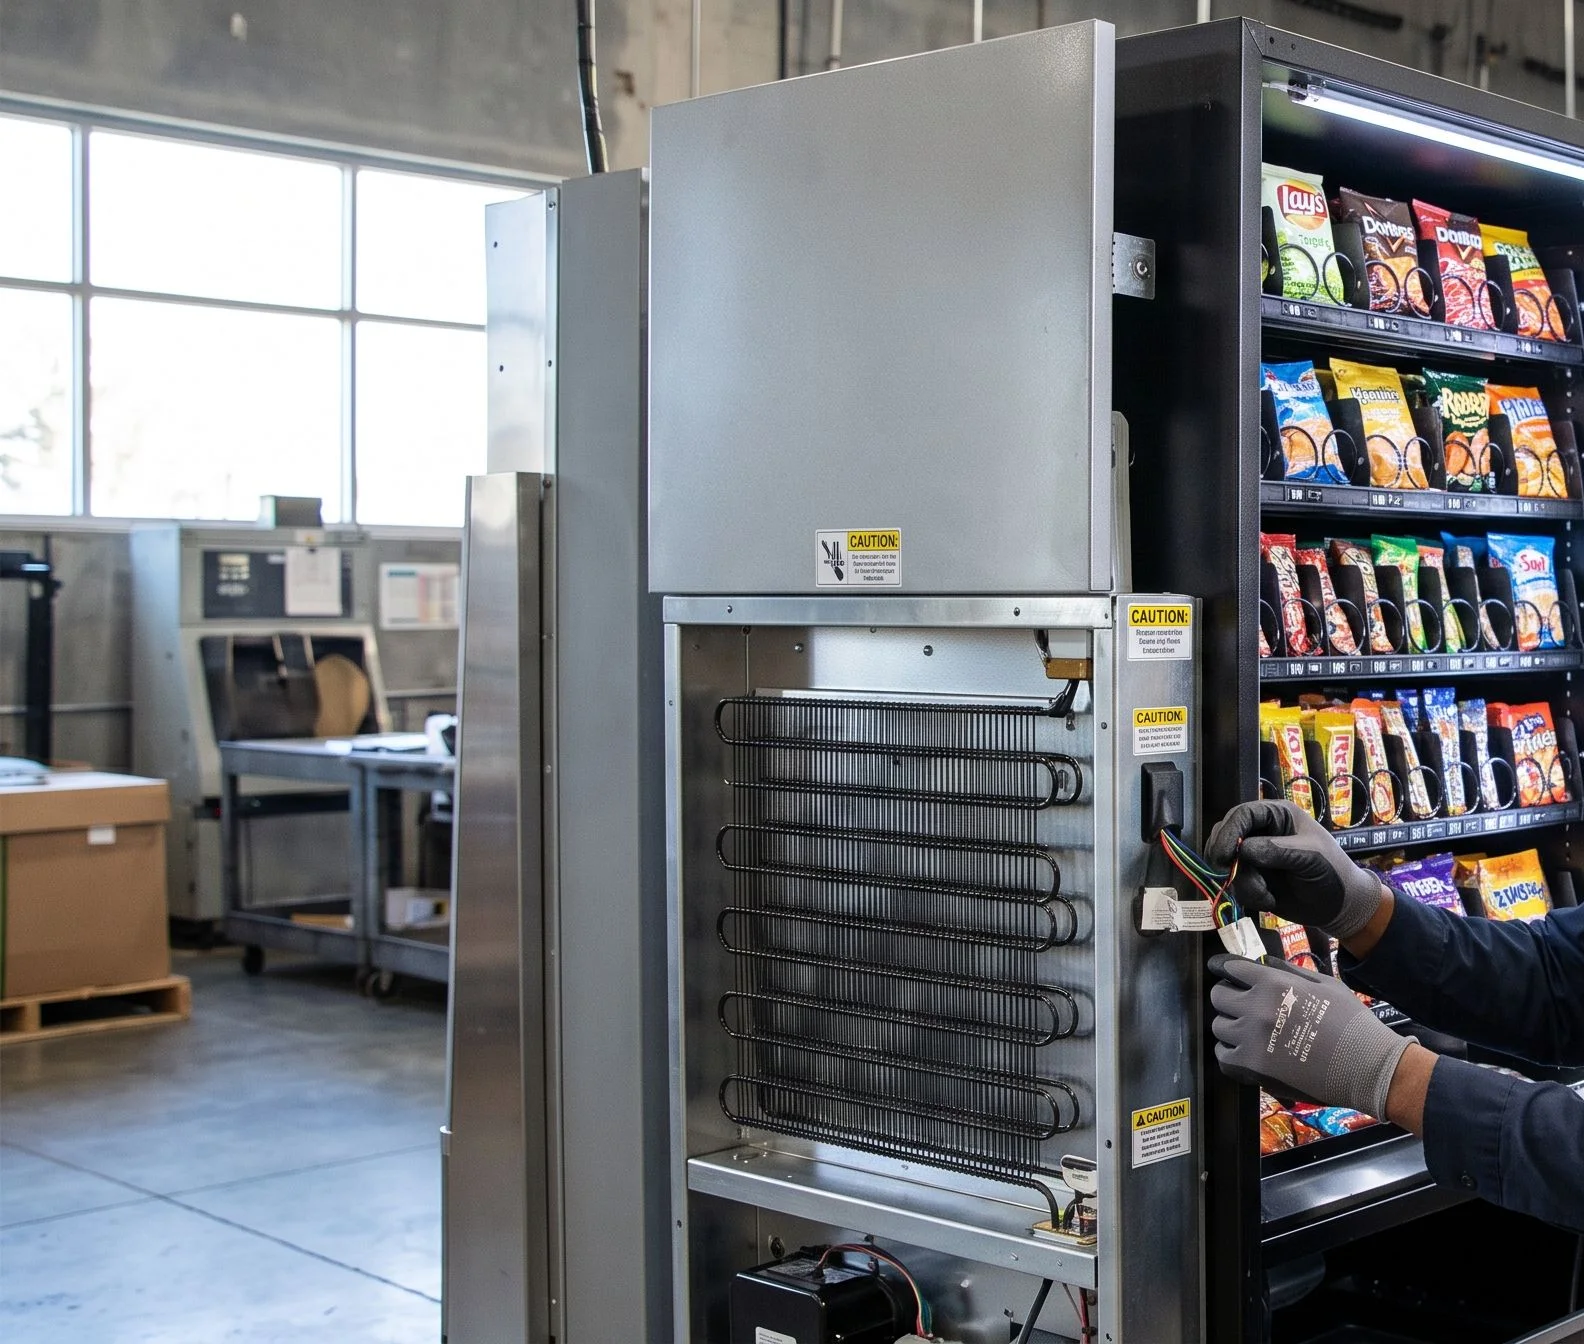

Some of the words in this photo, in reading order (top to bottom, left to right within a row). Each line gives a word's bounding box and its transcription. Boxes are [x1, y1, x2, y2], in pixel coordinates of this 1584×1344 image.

[850, 534, 898, 548] CAUTION:
[1131, 608, 1188, 624] CAUTION:
[1146, 1104, 1185, 1123] CAUTION
